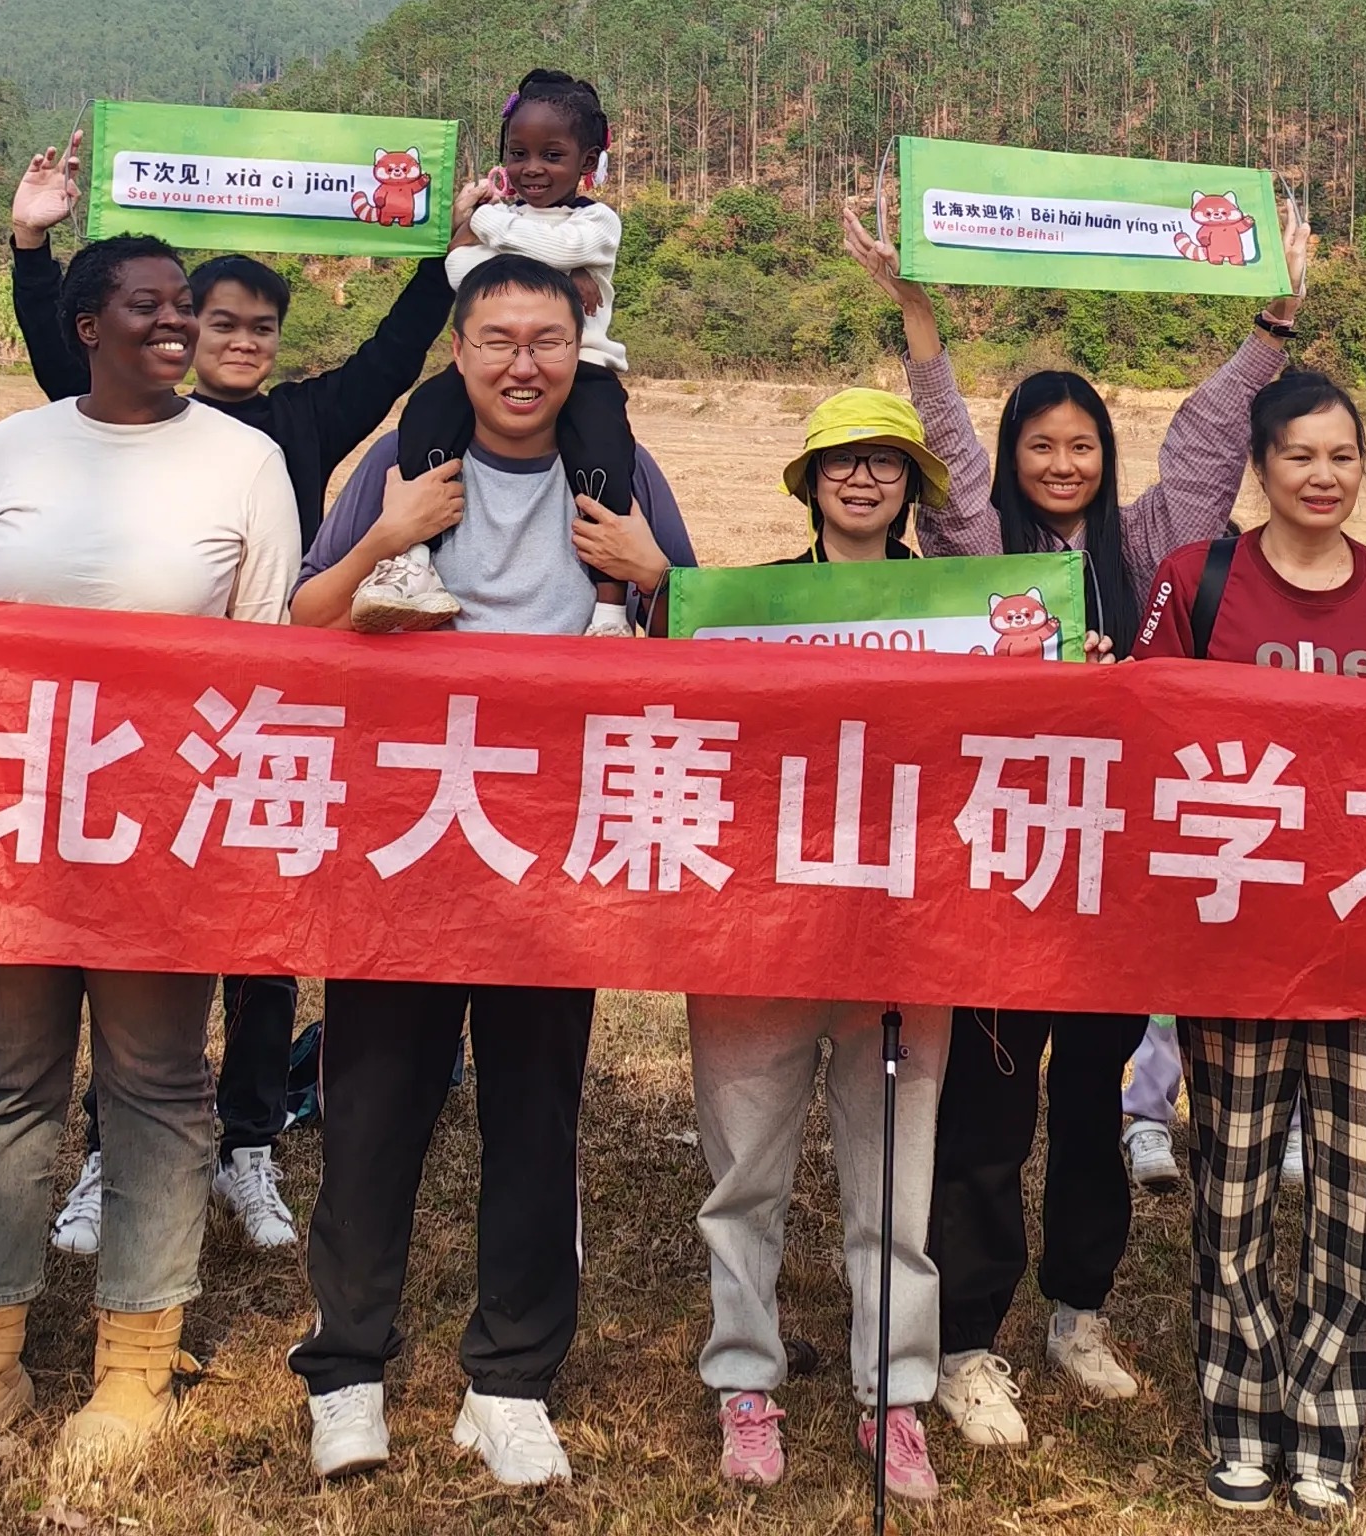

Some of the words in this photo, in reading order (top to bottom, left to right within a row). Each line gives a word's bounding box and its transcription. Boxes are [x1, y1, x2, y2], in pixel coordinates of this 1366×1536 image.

[129, 161, 210, 185] 下次见！
[225, 168, 261, 187] xià
[272, 170, 293, 189] cì
[304, 172, 355, 194] jiàn!
[127, 186, 157, 200] See
[162, 191, 191, 203] you
[196, 193, 232, 204] next
[237, 194, 280, 207] time!
[932, 200, 1021, 221] 北海欢迎你！
[933, 220, 996, 236] Welcome
[1000, 226, 1013, 237] to
[1017, 226, 1064, 242] Beihai!
